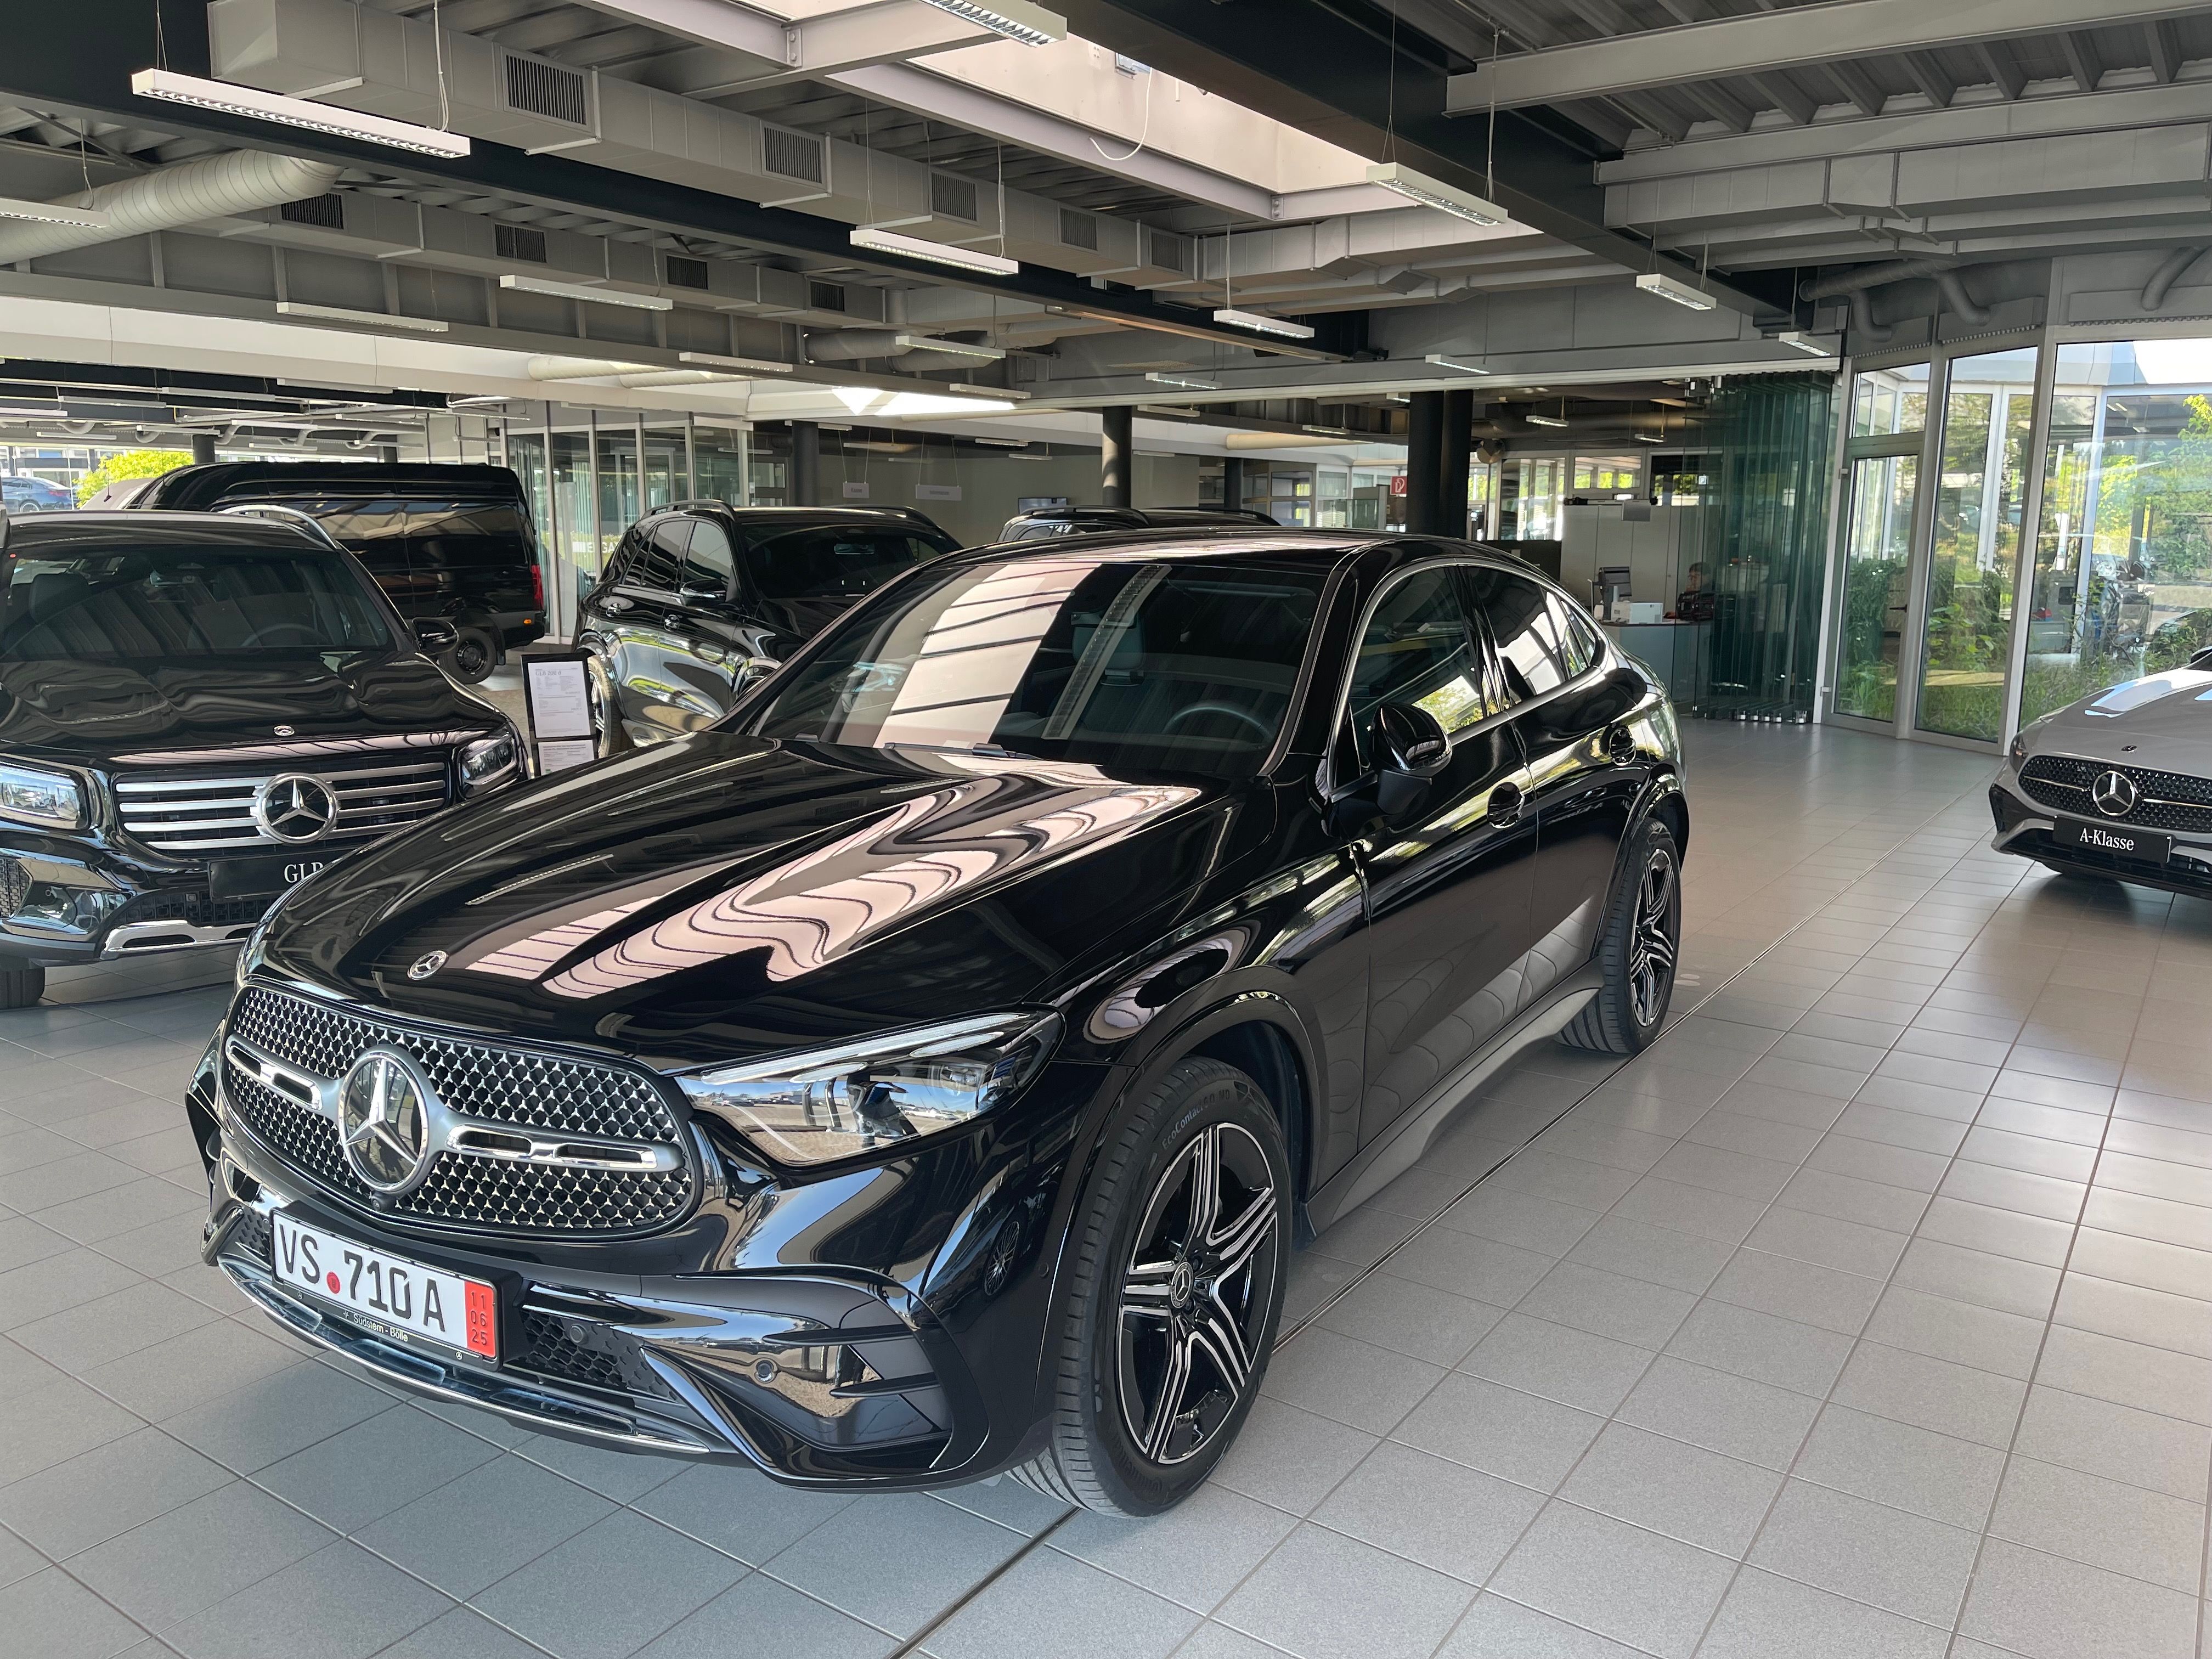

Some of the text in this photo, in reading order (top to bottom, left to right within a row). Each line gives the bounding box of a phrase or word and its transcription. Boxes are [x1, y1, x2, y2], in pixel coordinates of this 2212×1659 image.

[2079, 827, 2135, 851] A-Klasse
[1161, 1101, 1205, 1150] EcoContact
[280, 1223, 446, 1332] VS 710 A
[470, 1291, 487, 1309] 11
[353, 1313, 384, 1334] Südstern
[390, 1328, 408, 1342] Bölle
[470, 1312, 487, 1327] 06
[471, 1329, 488, 1346] 25
